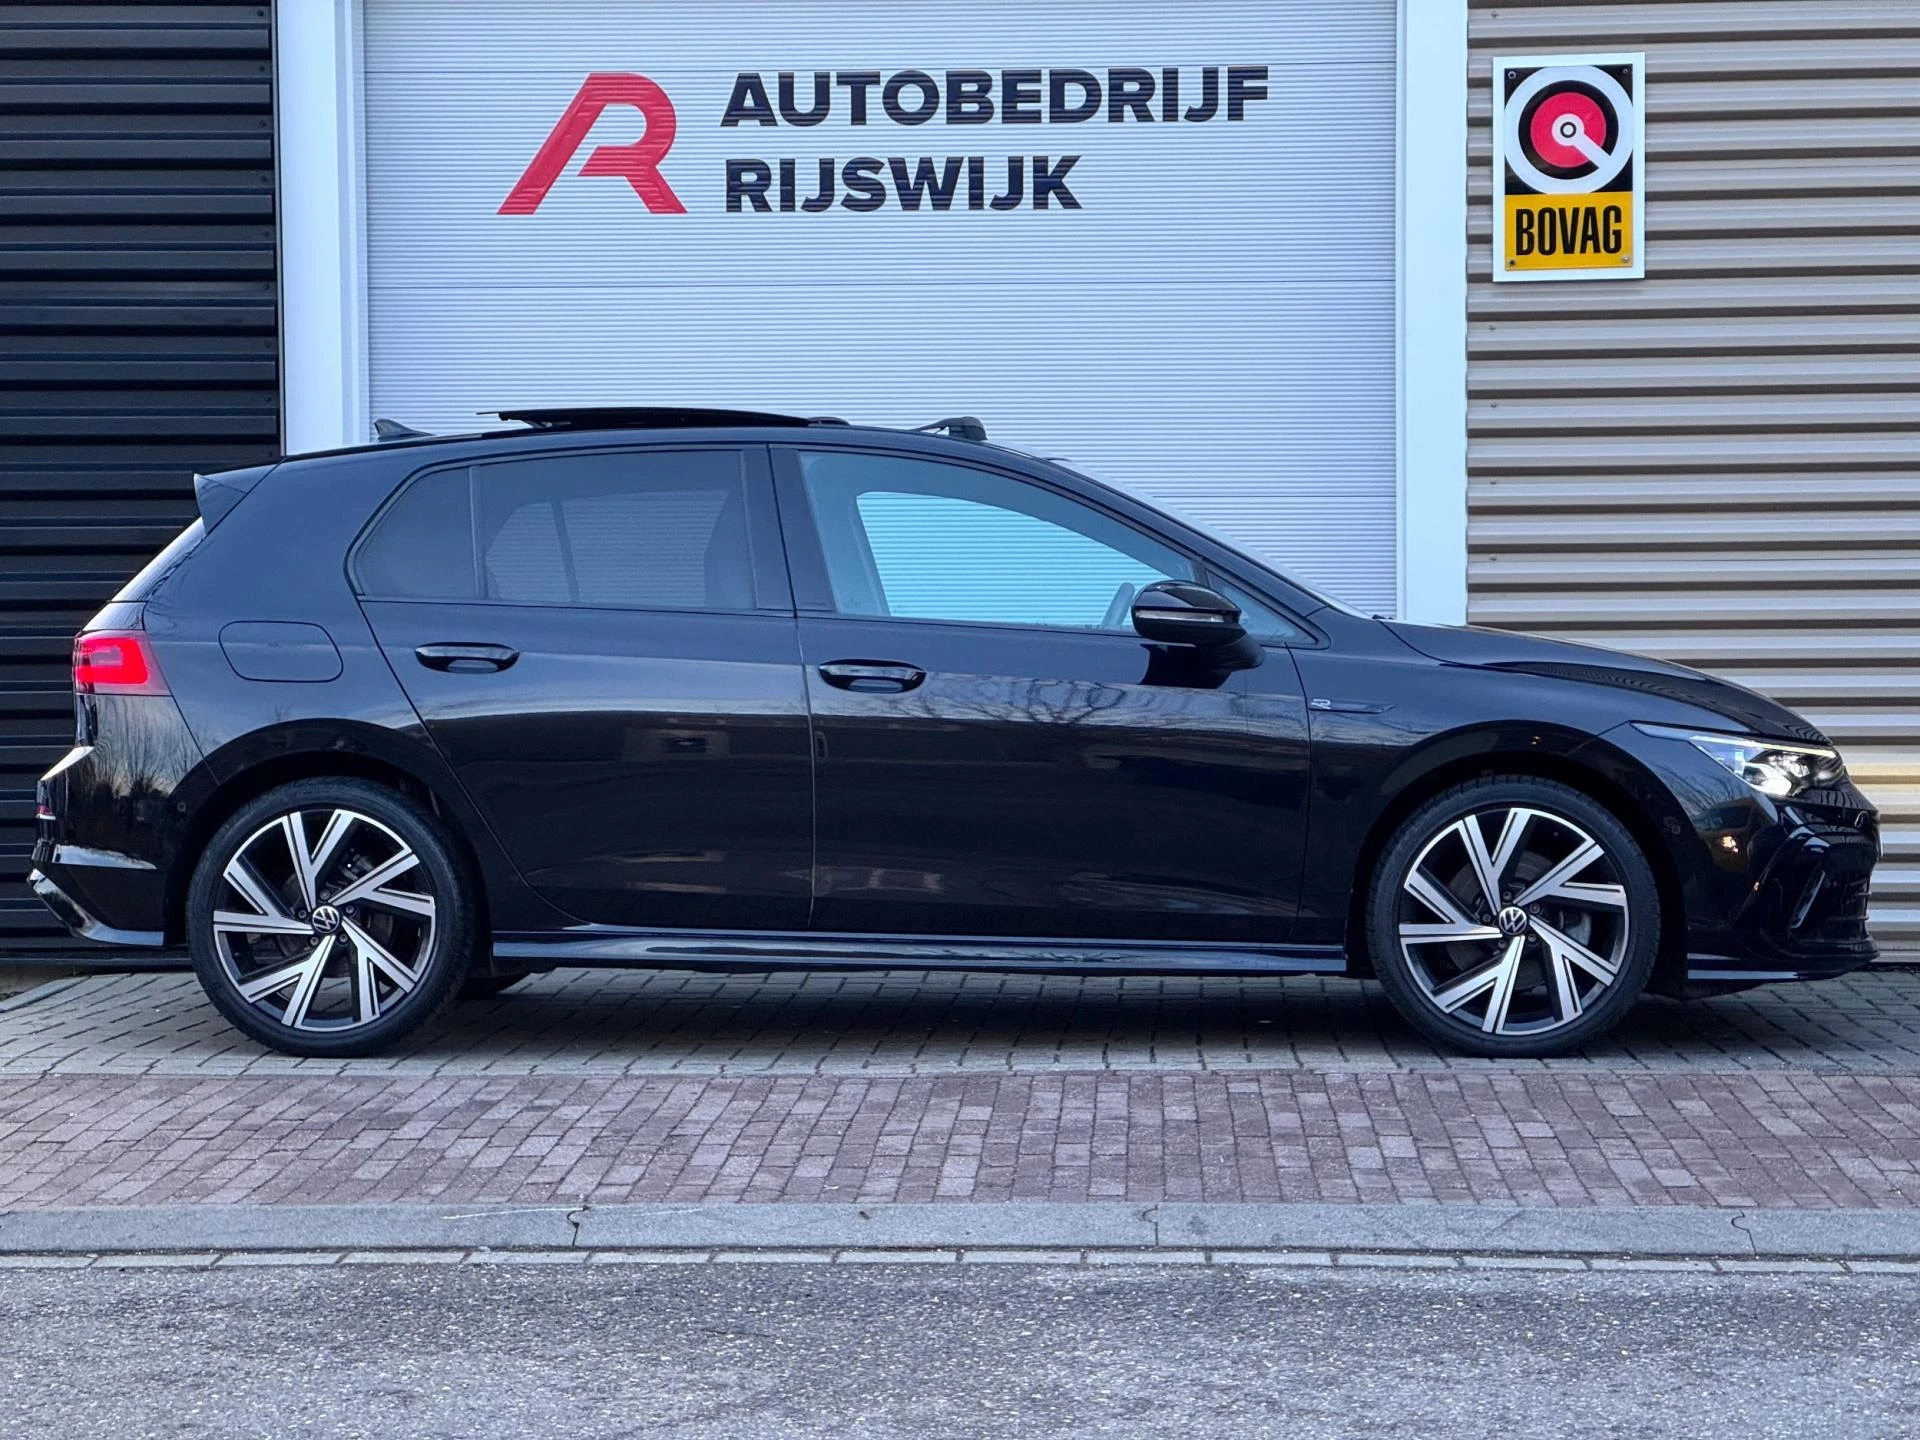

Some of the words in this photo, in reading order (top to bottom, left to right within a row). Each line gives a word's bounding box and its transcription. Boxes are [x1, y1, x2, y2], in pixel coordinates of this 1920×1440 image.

[720, 66, 1269, 127] AUTOBEDRIJF
[725, 156, 1082, 213] RIJSWIJK
[1515, 205, 1622, 256] BOVAG
